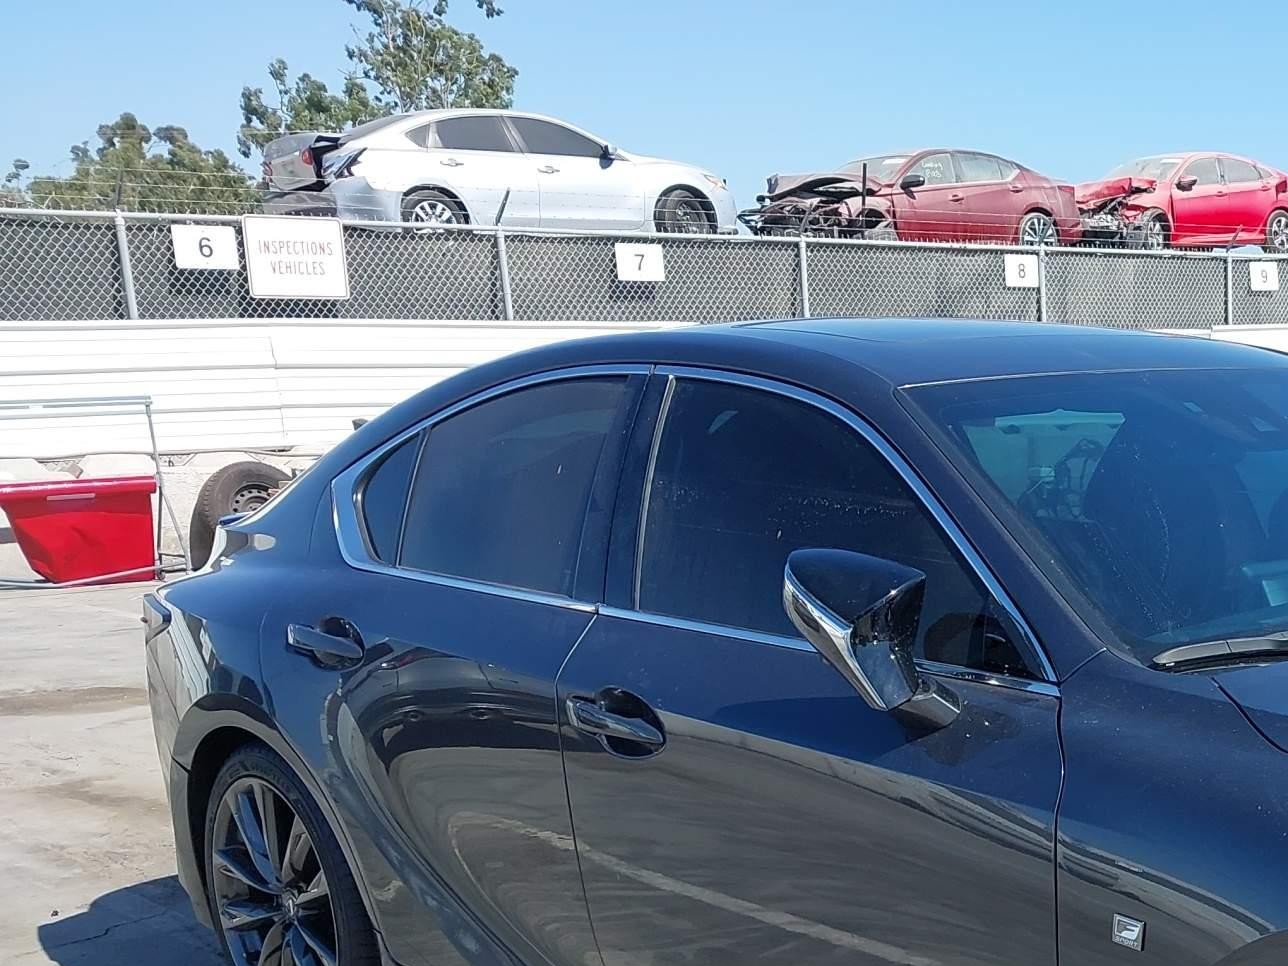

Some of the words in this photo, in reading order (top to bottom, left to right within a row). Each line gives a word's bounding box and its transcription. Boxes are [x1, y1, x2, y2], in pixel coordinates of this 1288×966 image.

[198, 237, 214, 258] 6
[258, 240, 334, 256] INSPECTIONS
[270, 261, 326, 276] VEHICLES
[633, 253, 645, 271] 7
[1018, 263, 1026, 279] 8
[1260, 270, 1268, 284] 9
